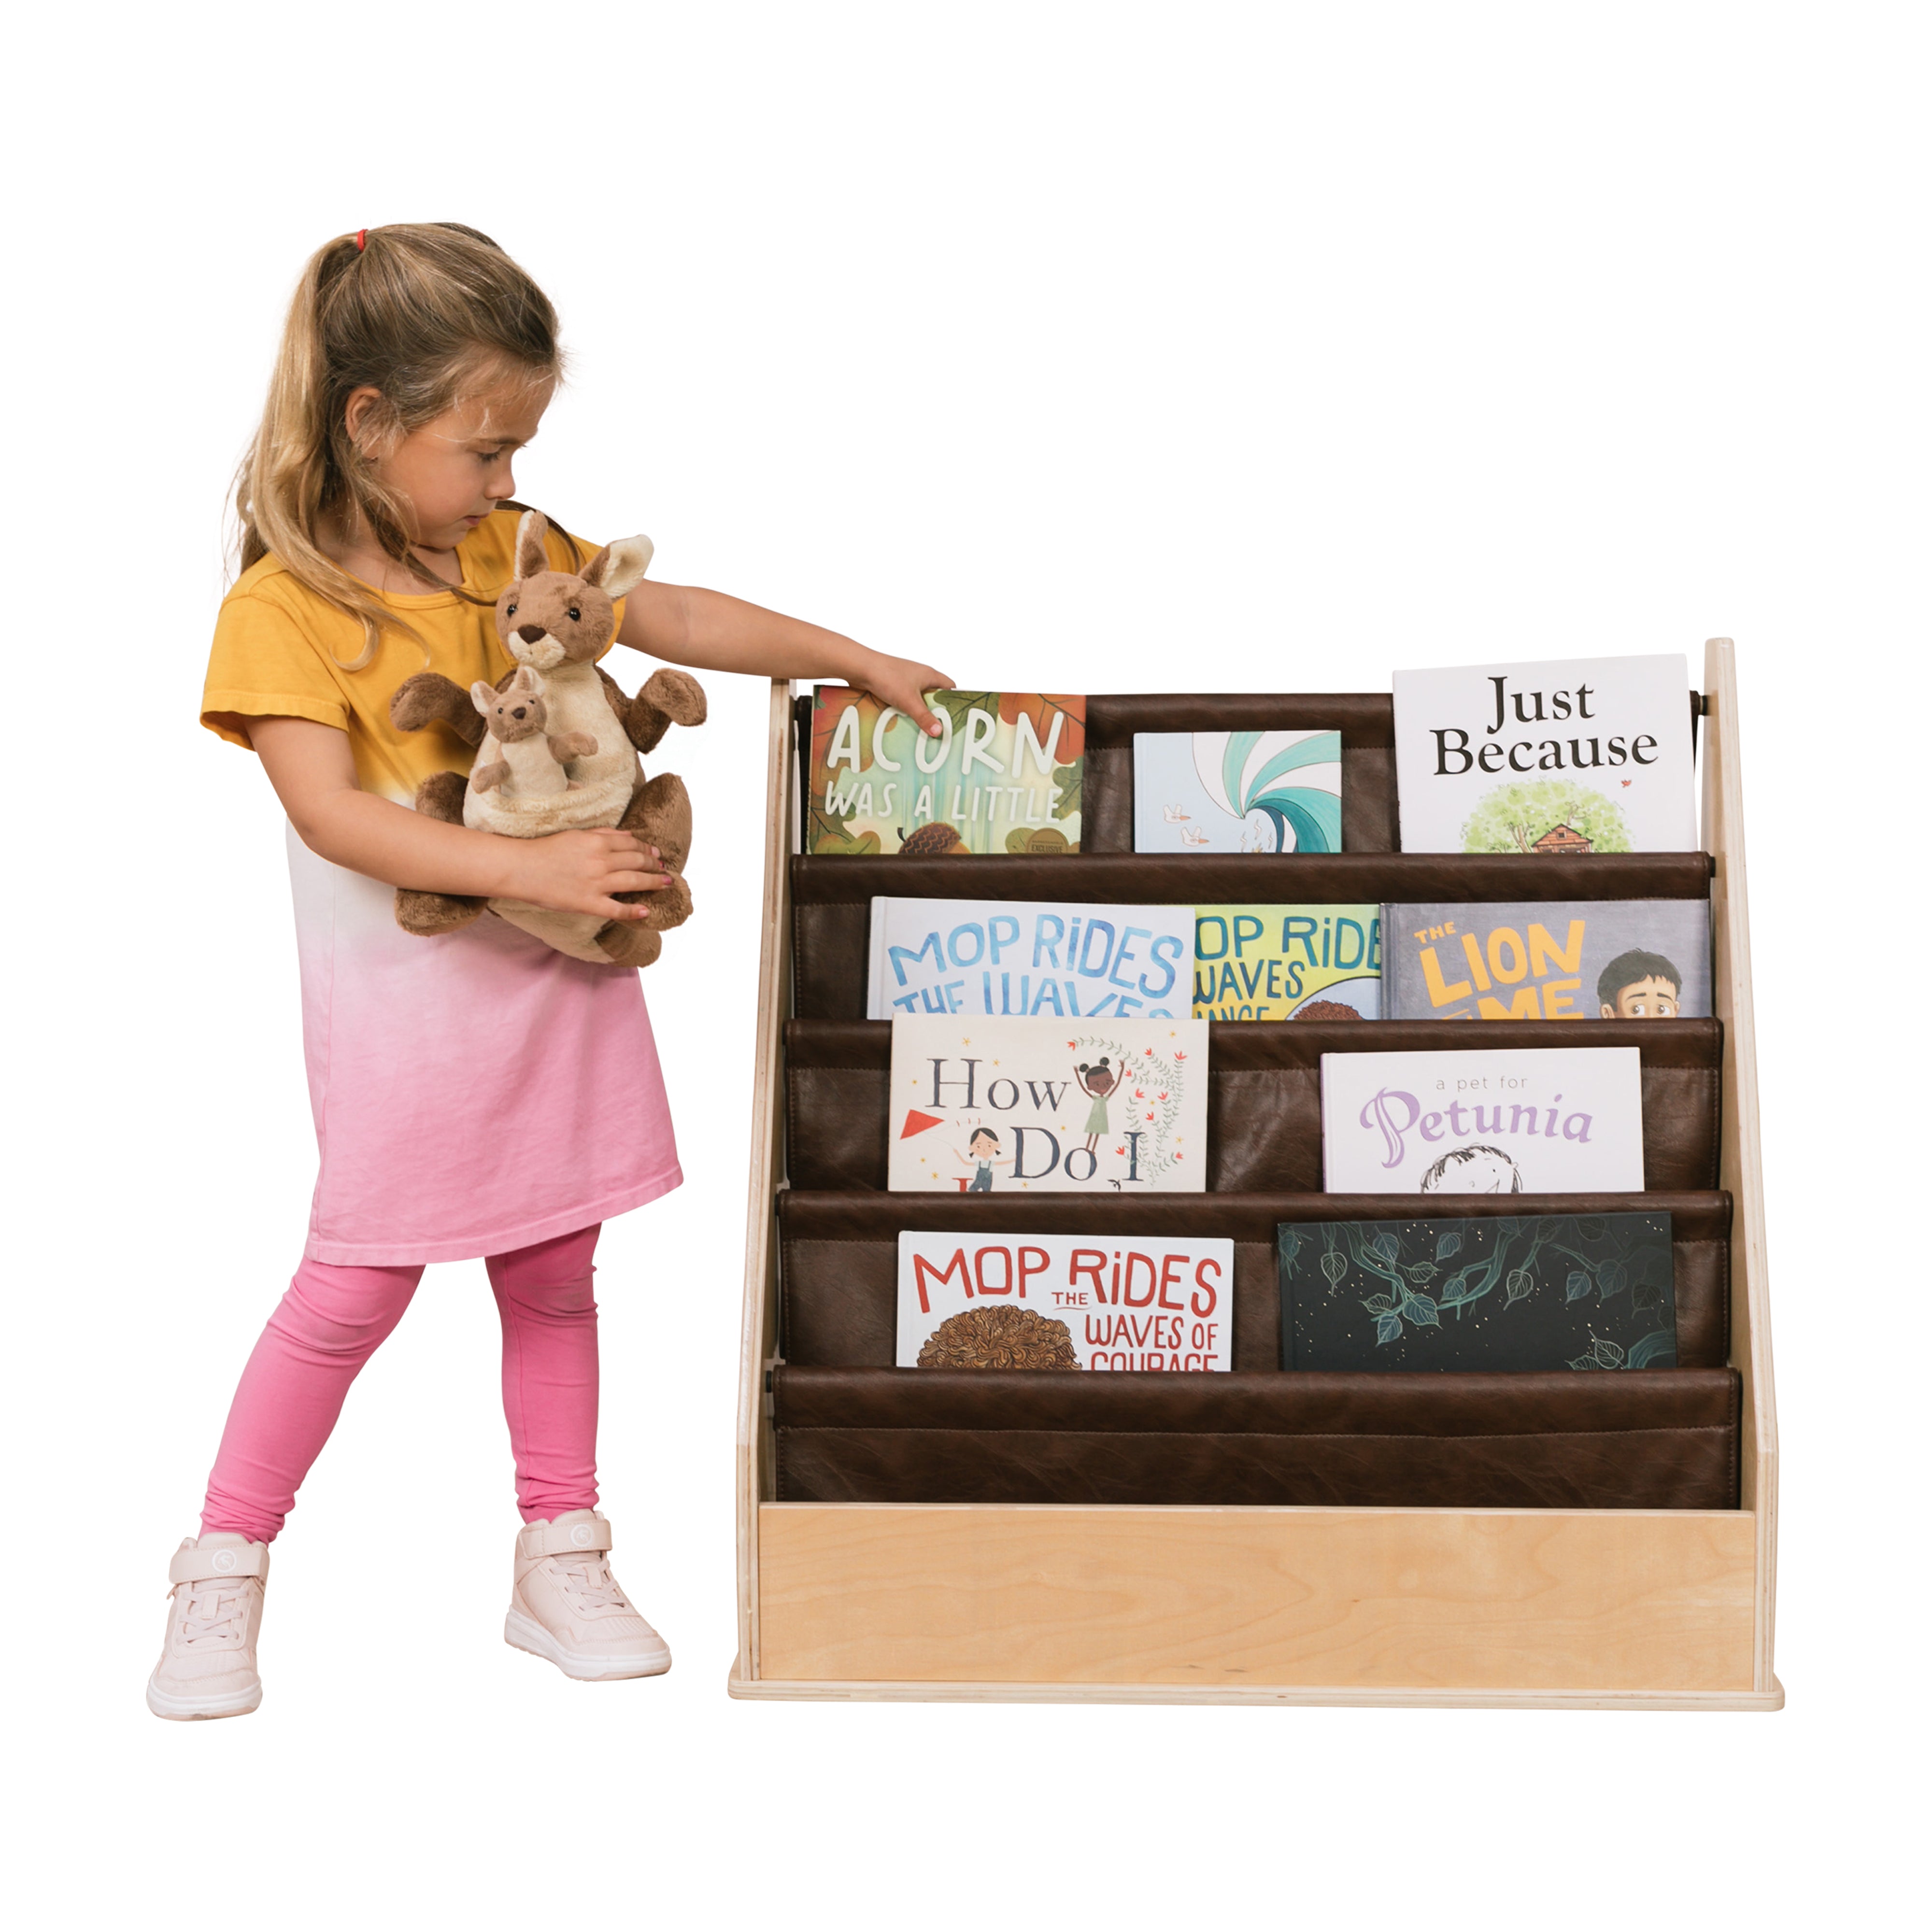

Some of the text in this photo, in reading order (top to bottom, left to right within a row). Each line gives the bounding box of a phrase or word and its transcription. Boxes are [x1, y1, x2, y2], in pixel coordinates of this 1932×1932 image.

[1486, 676, 1596, 734] Just
[826, 705, 1064, 778] ACORN
[1429, 728, 1659, 776] Because
[825, 780, 1064, 822] WAS A LITTLE
[888, 915, 1020, 986] MOP
[1413, 921, 1457, 944] THE
[1419, 920, 1586, 1008] LION
[1477, 978, 1584, 1020] ME
[925, 1058, 1072, 1111] How
[1435, 1075, 1528, 1093] a pet for
[1008, 1126, 1145, 1181] Do I
[1359, 1087, 1593, 1169] Petunia
[913, 1246, 1051, 1314] MOP
[1051, 1292, 1089, 1305] THE
[1085, 1314, 1219, 1350] WAVES OF
